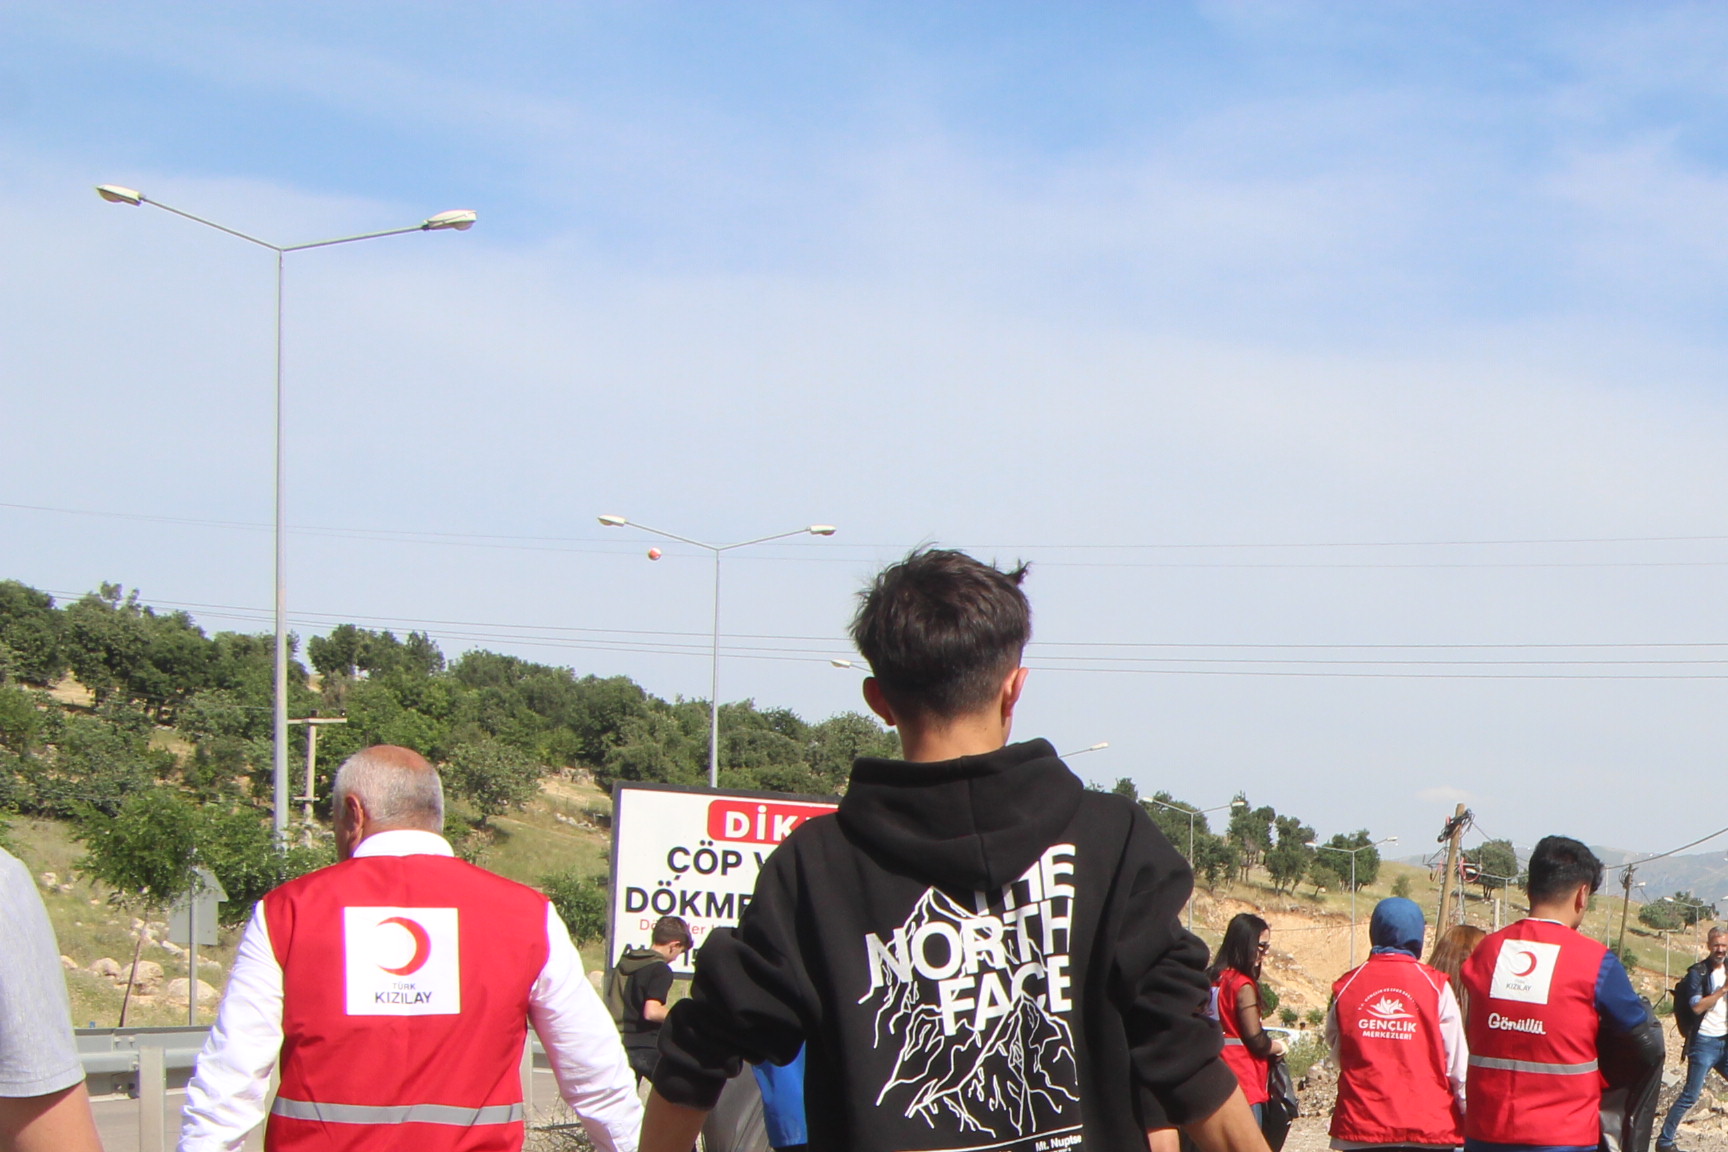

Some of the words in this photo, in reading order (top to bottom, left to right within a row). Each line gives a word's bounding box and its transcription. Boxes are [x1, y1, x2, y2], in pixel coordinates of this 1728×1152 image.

[725, 804, 812, 842] DİK
[666, 840, 743, 881] ÇÖP
[864, 897, 1074, 988] NORTH
[393, 982, 416, 990] TÜRK
[938, 954, 1073, 1037] FACE
[1505, 983, 1532, 992] KIZILAY
[374, 991, 433, 1005] KIZILAY
[1358, 1018, 1417, 1033] GENÇLİK
[1488, 1012, 1547, 1036] Gönüllü
[1362, 1030, 1412, 1040] MERKEZLERİ
